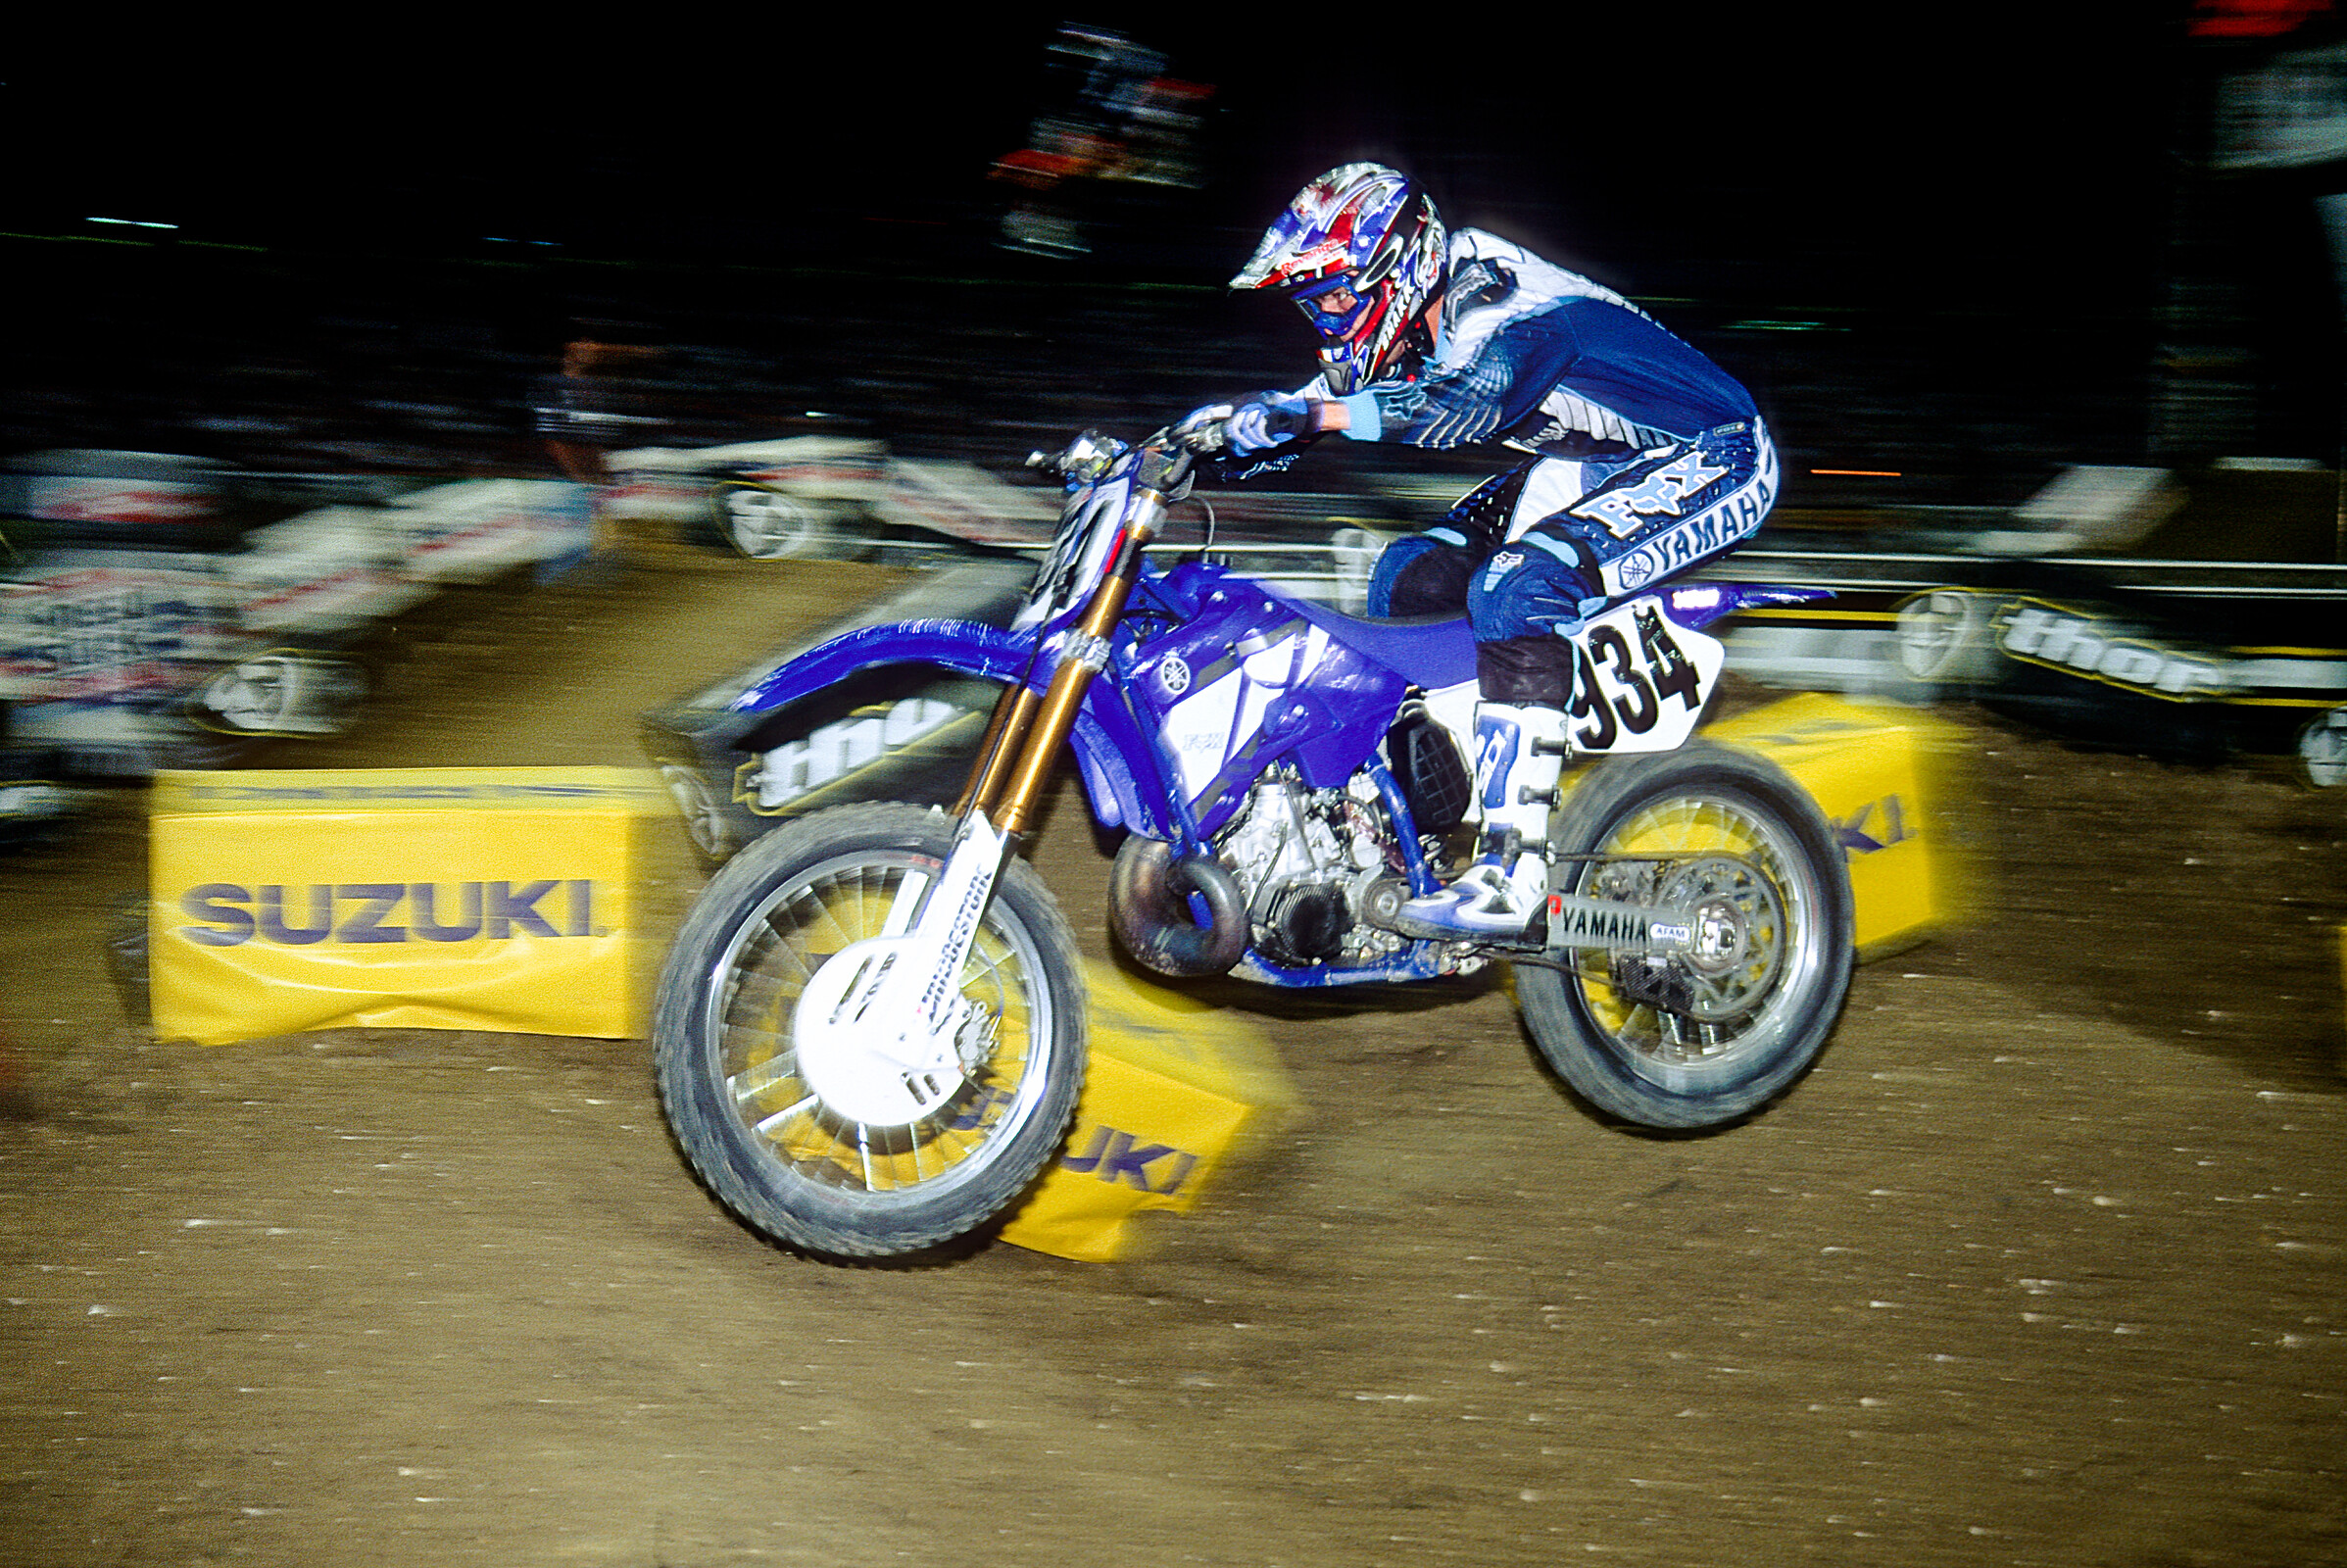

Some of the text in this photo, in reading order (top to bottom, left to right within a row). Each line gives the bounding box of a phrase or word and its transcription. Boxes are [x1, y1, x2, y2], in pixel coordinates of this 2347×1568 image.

[1653, 478, 1771, 572] YAMAHA
[1570, 605, 1701, 750] 934
[2002, 608, 2223, 694] thor
[180, 879, 592, 947] SUZUKI
[1562, 906, 1646, 942] YAMAHA
[1655, 927, 1686, 938] AFAM
